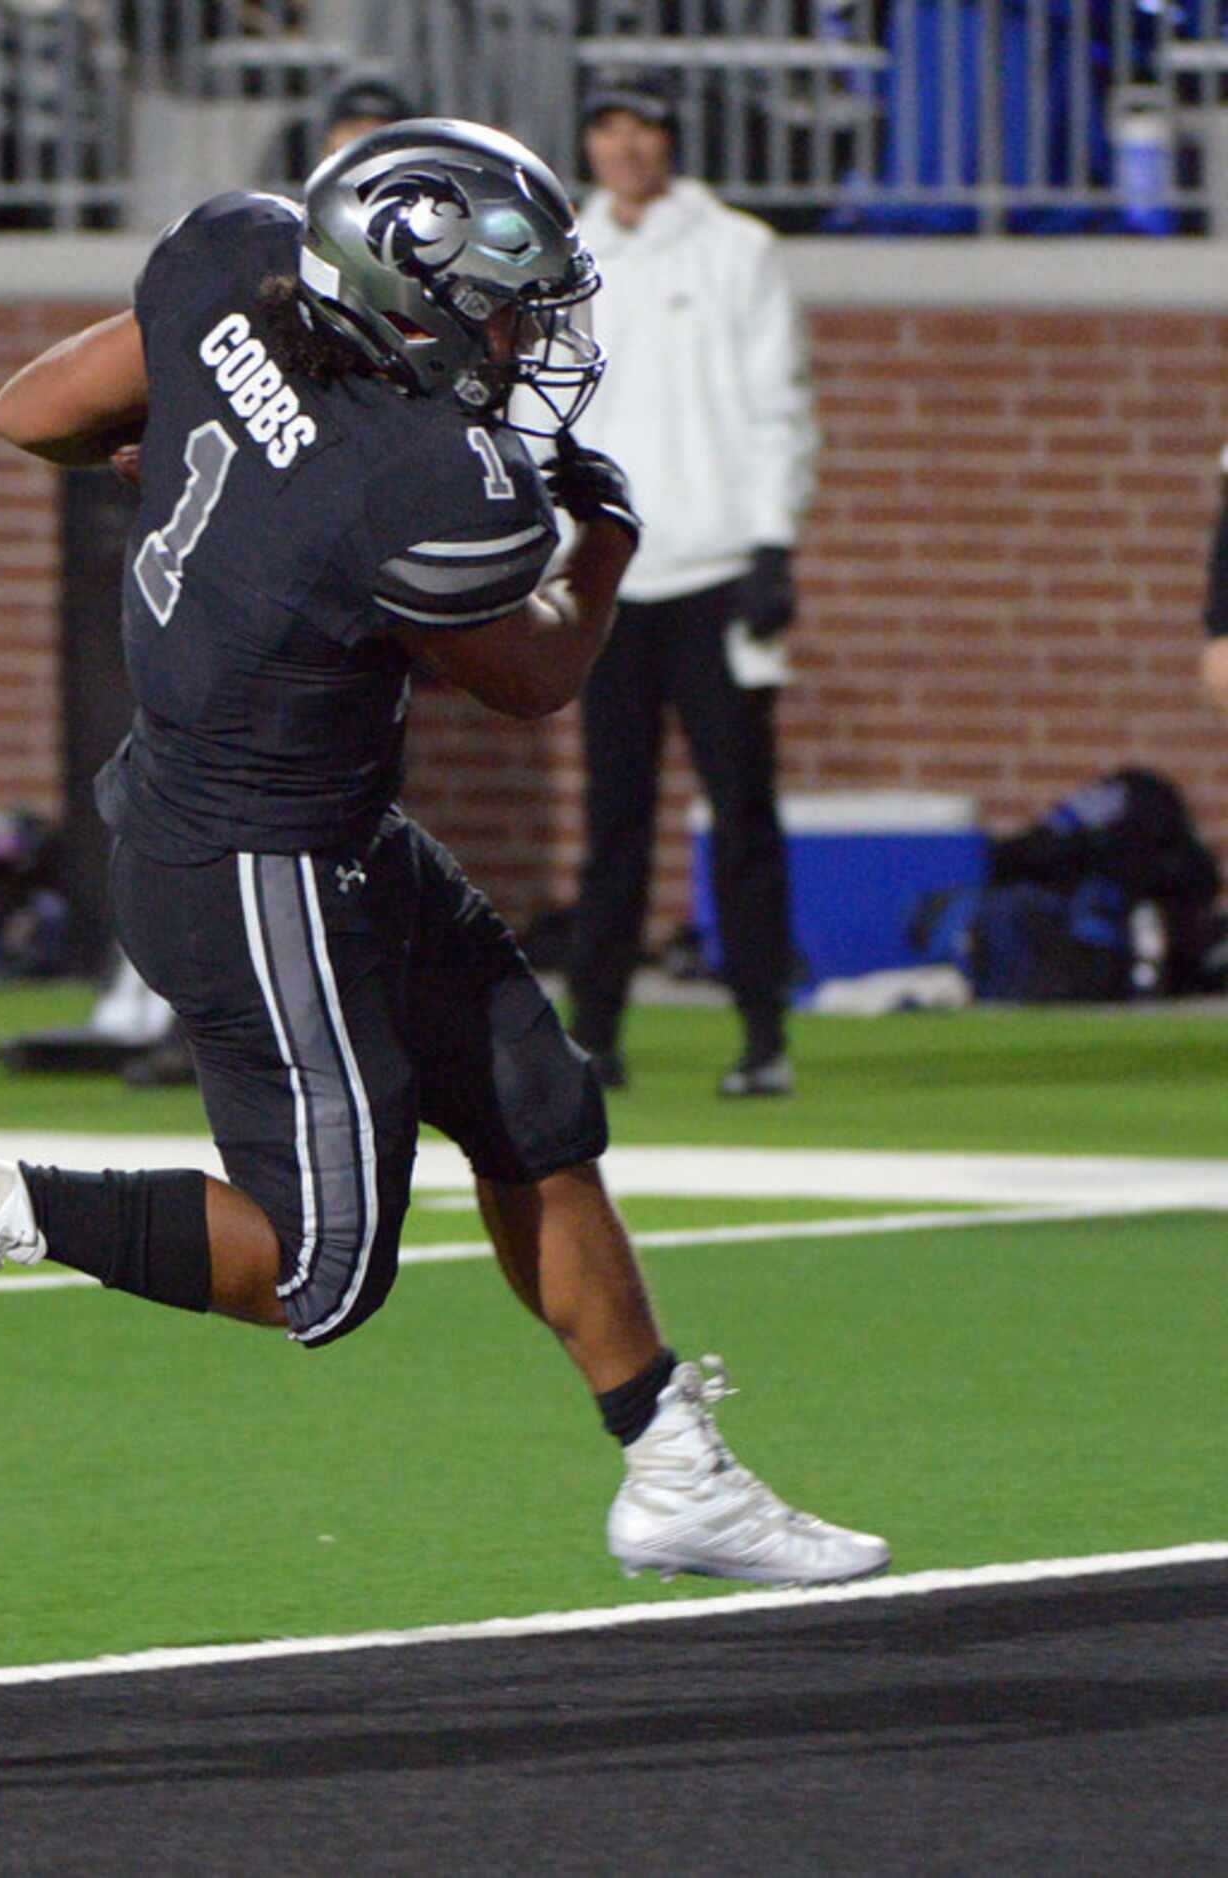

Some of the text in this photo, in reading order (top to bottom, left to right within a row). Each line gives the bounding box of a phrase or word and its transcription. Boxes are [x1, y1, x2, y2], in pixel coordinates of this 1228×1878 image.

[199, 313, 317, 469] COBBS
[467, 426, 515, 501] 1
[133, 420, 239, 627] 1
